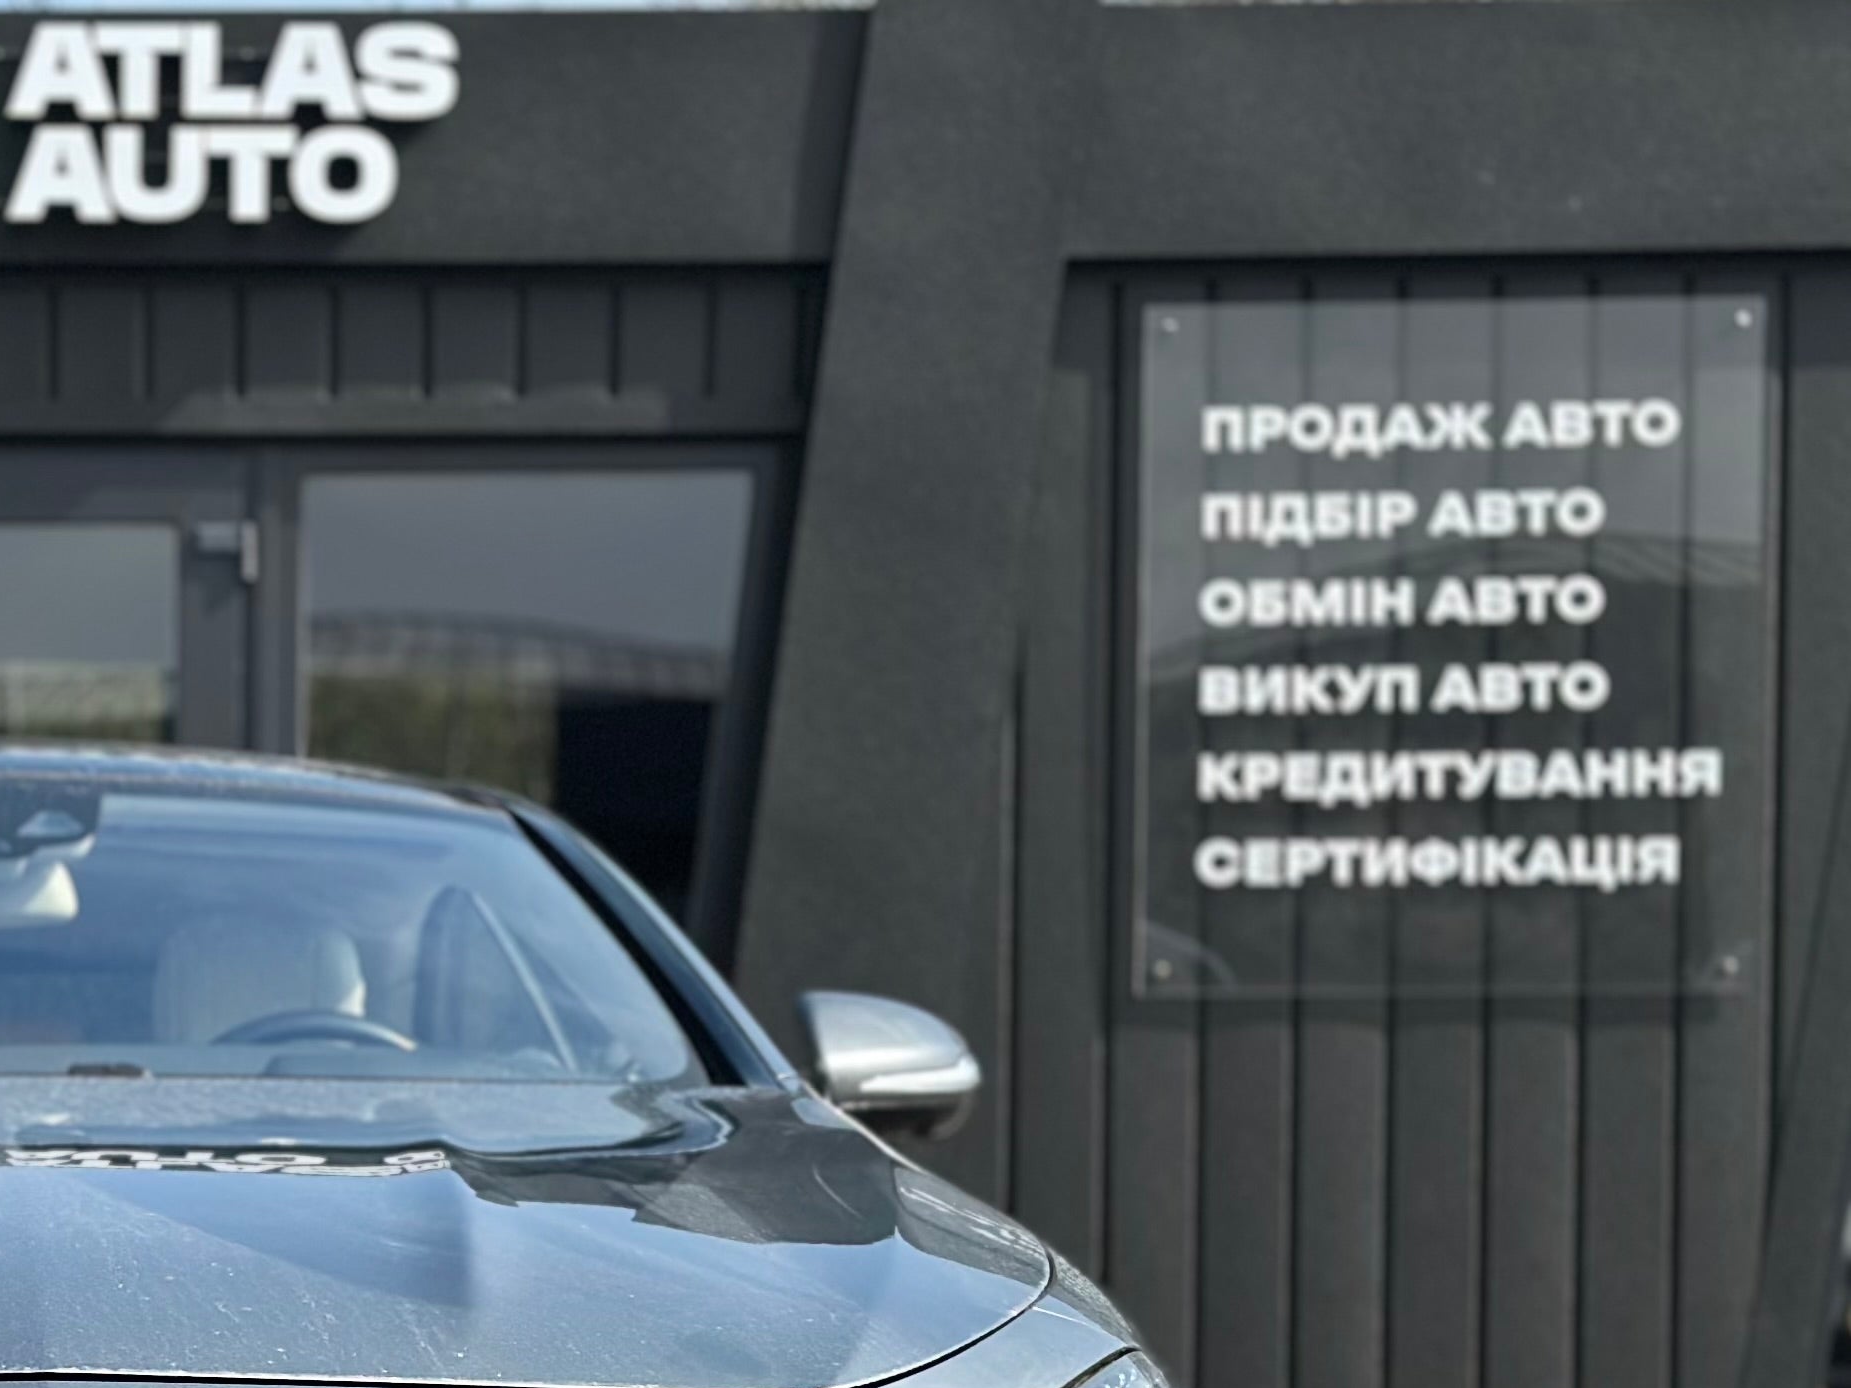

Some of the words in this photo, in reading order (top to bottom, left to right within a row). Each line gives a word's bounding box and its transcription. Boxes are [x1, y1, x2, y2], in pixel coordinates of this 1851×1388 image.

[6, 20, 459, 122] ATLAS
[6, 125, 399, 224] AUTO
[1201, 403, 1494, 460] ПРОДАЖ
[1502, 397, 1684, 450] АВТО
[1200, 491, 1419, 546] ПІДБІР
[1426, 487, 1607, 538] АВТО
[1197, 577, 1415, 628] ОБМІН
[1426, 574, 1606, 624] АВТО
[1197, 664, 1420, 715] ВИКУП
[1431, 661, 1610, 712] АВТО
[1196, 748, 1723, 807] КРЕДИТУВАННЯ
[1194, 835, 1680, 892] СЕРТИФІКАЦІЯ
